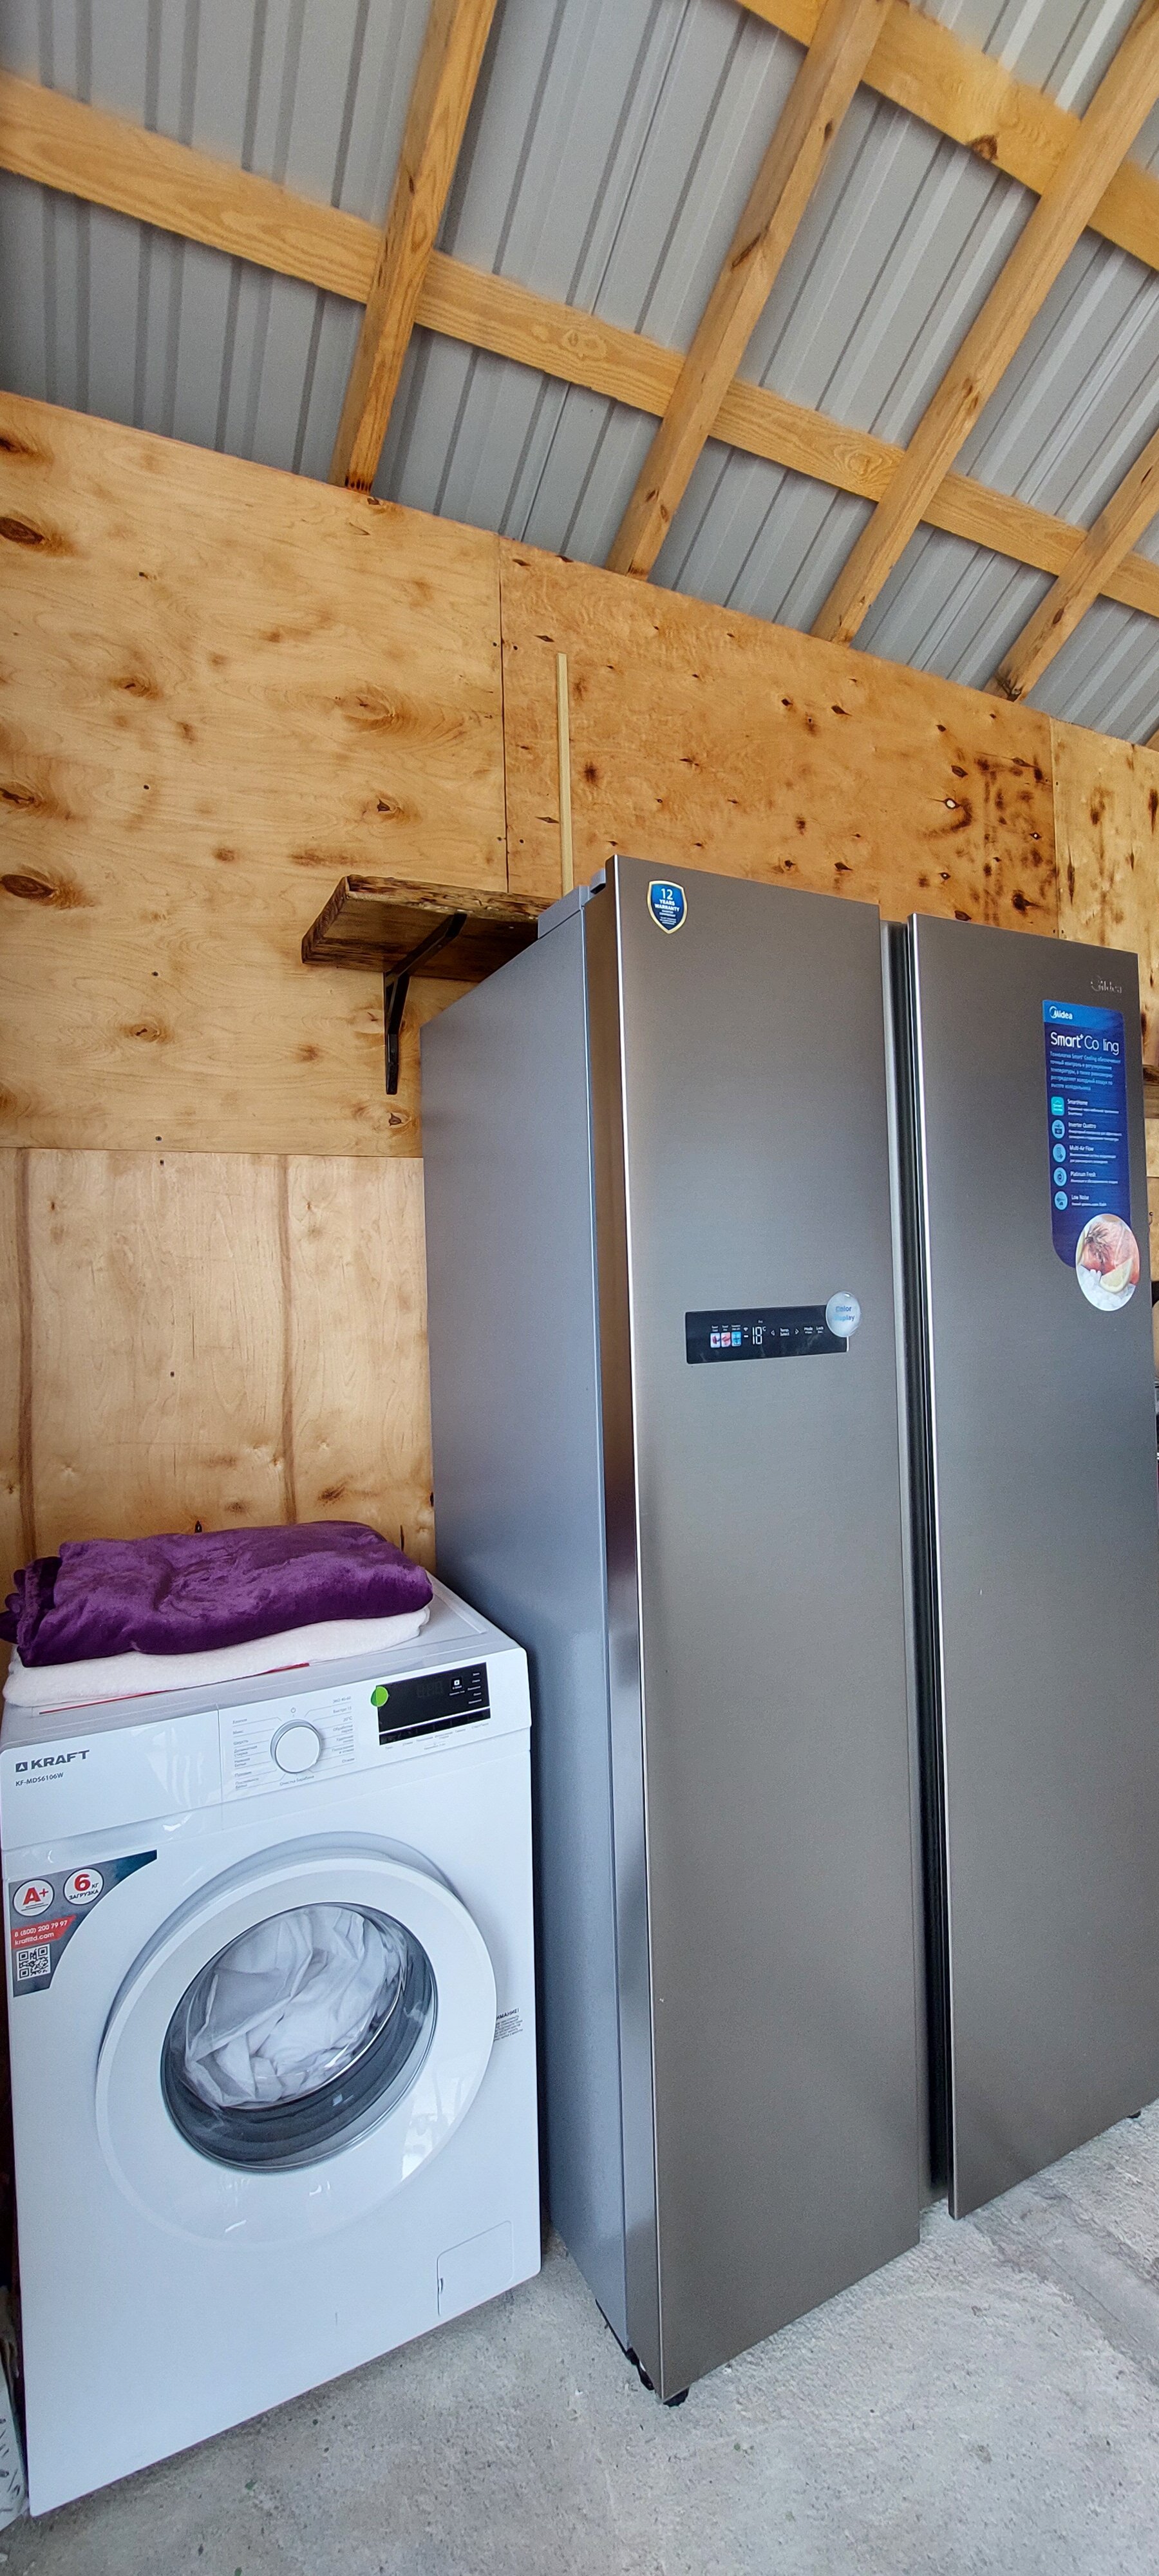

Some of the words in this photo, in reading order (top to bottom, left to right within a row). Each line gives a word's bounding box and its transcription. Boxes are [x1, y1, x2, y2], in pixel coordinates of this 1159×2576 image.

[661, 888, 674, 900] 12
[654, 904, 680, 912] WARRANTY
[1049, 1005, 1073, 1020] Midea
[31, 1750, 90, 1770] KRAFT
[74, 1873, 91, 1892] 6
[68, 1889, 99, 1900] ЗАГРУЗКА
[38, 1924, 50, 1932] 200
